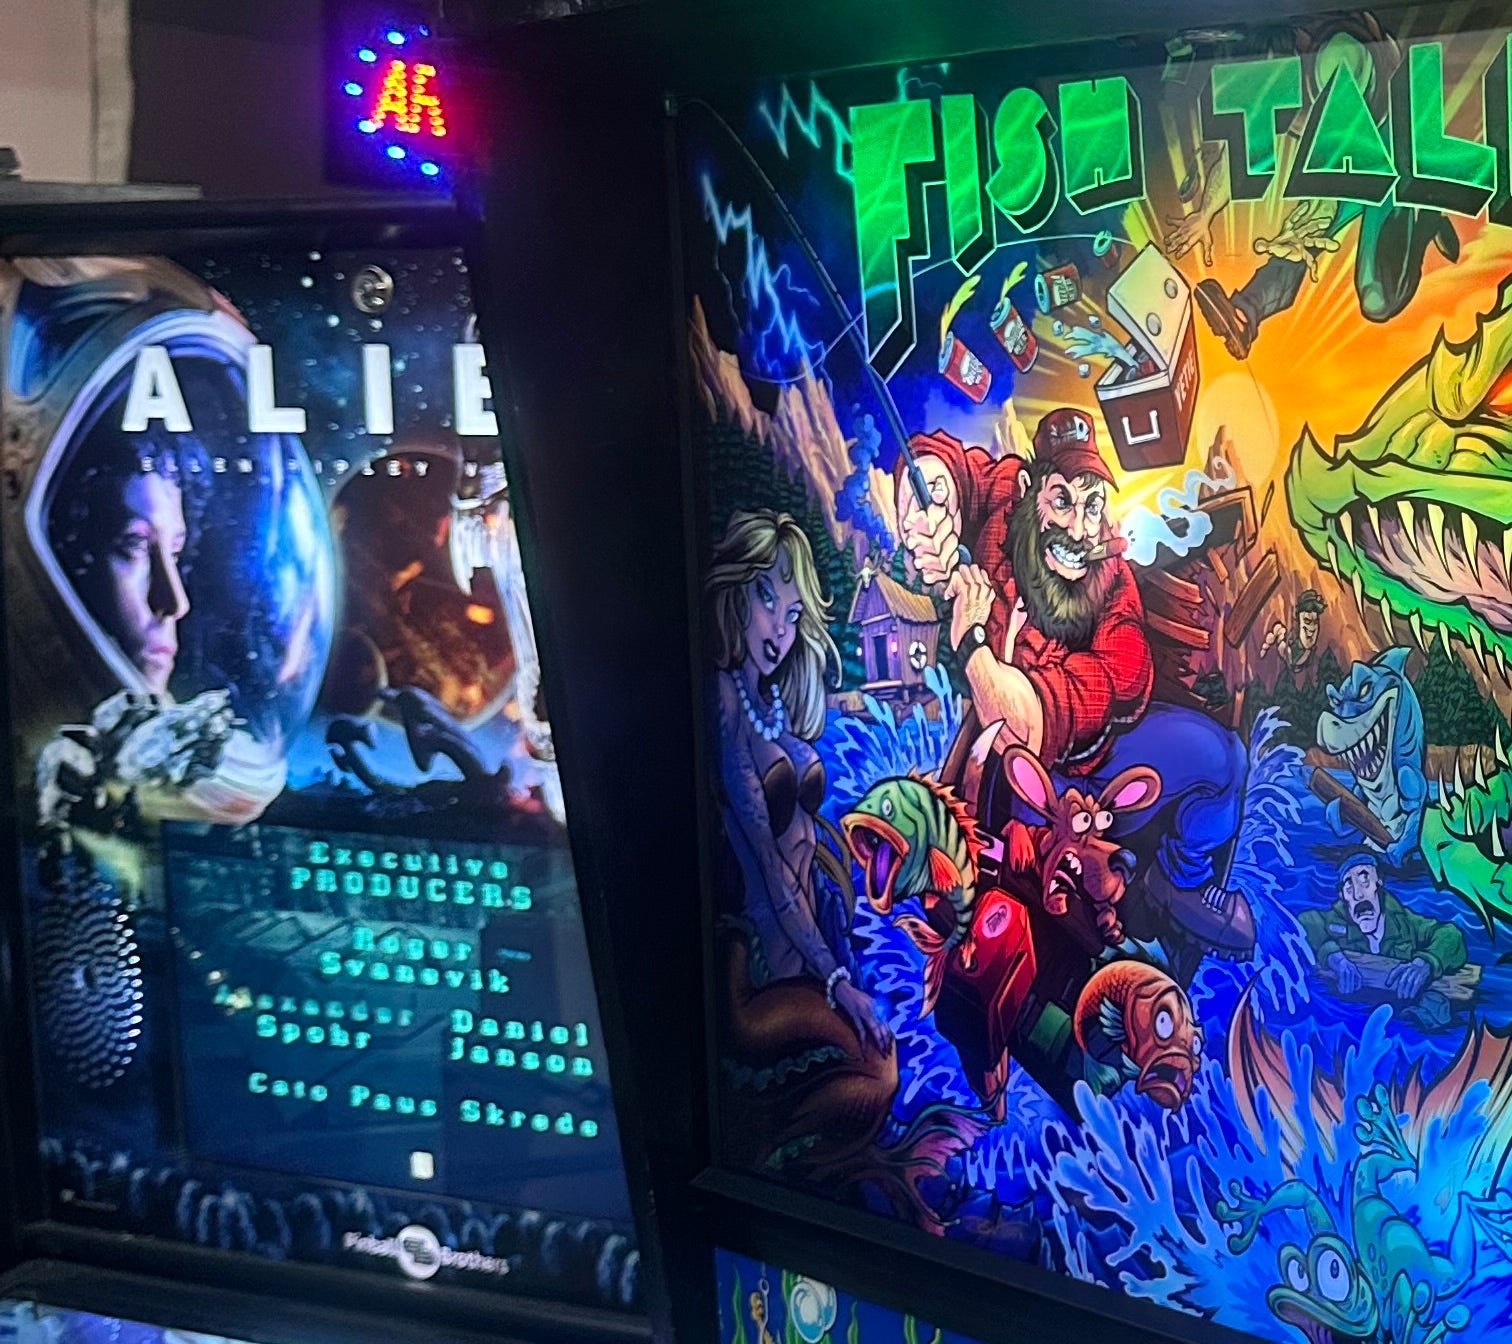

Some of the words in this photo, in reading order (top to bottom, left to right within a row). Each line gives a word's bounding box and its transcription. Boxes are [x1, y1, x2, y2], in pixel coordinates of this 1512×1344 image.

[847, 75, 1145, 383] FISH
[121, 343, 499, 436] ALIE
[308, 841, 509, 879] Executive
[290, 866, 532, 911] PRODUCERS
[353, 926, 473, 961] Roger
[450, 1008, 589, 1047] Daniel
